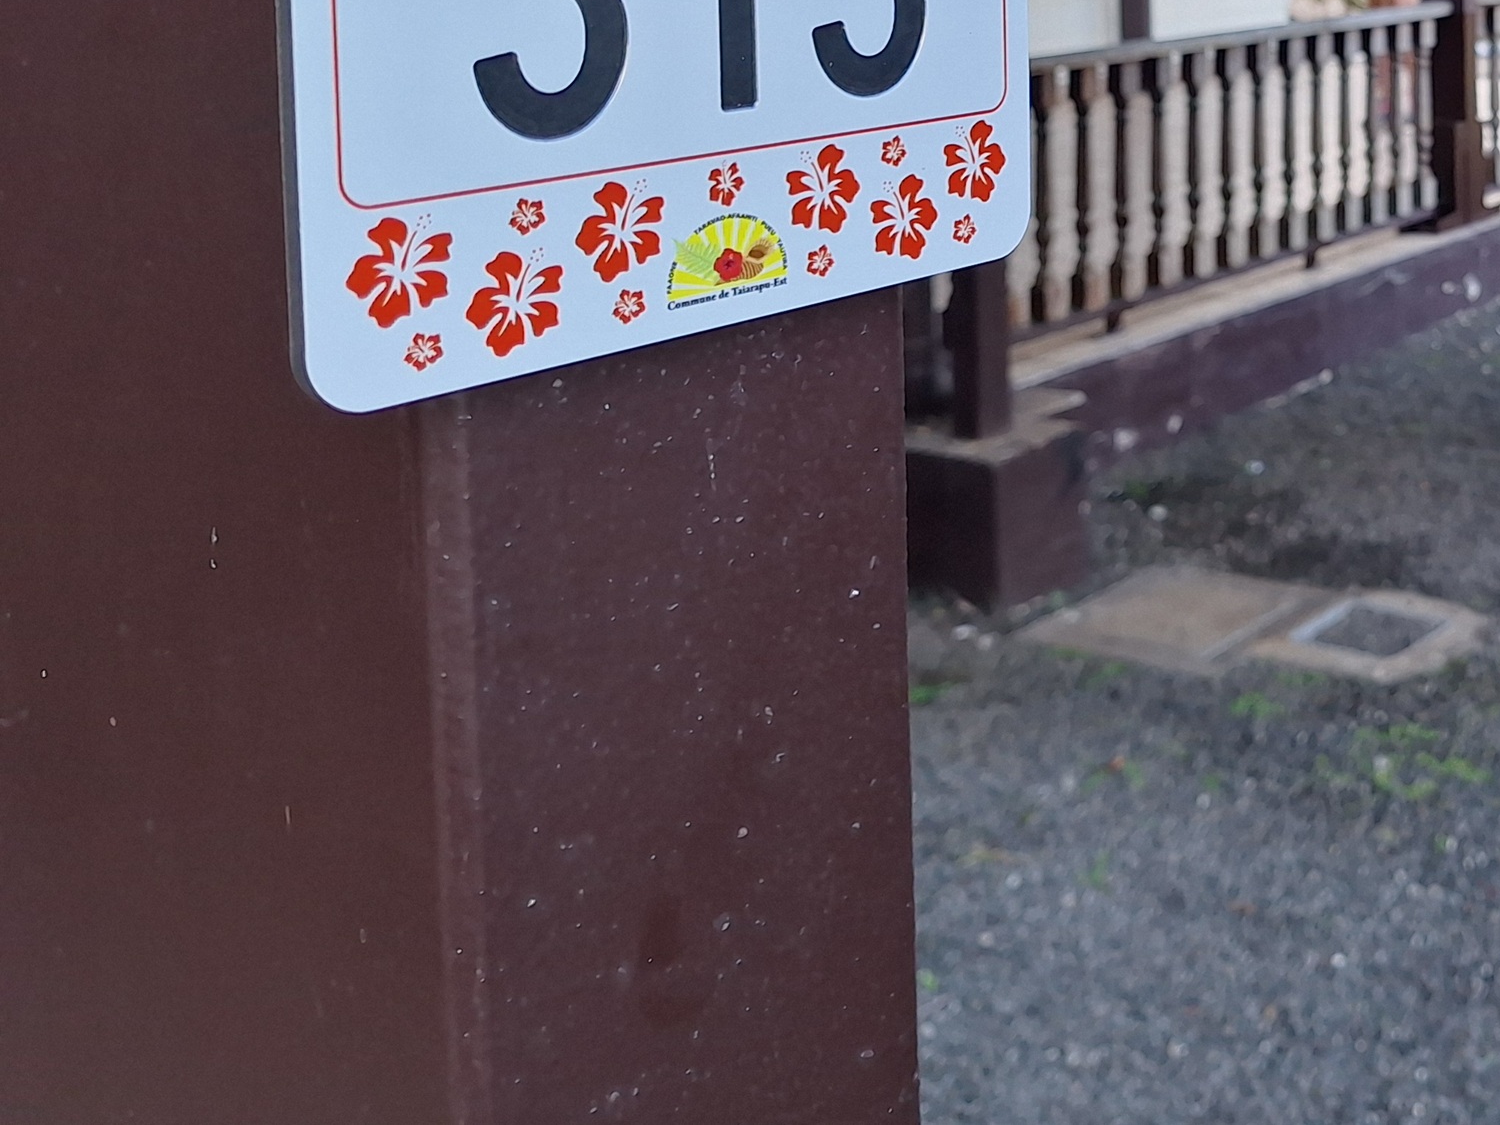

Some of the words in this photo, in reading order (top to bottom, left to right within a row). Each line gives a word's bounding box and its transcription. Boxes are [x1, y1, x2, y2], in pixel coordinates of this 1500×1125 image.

[761, 220, 776, 236] PUEU
[667, 293, 717, 311] Commune
[718, 289, 730, 300] de
[731, 277, 788, 296] Taiarapu-Est
